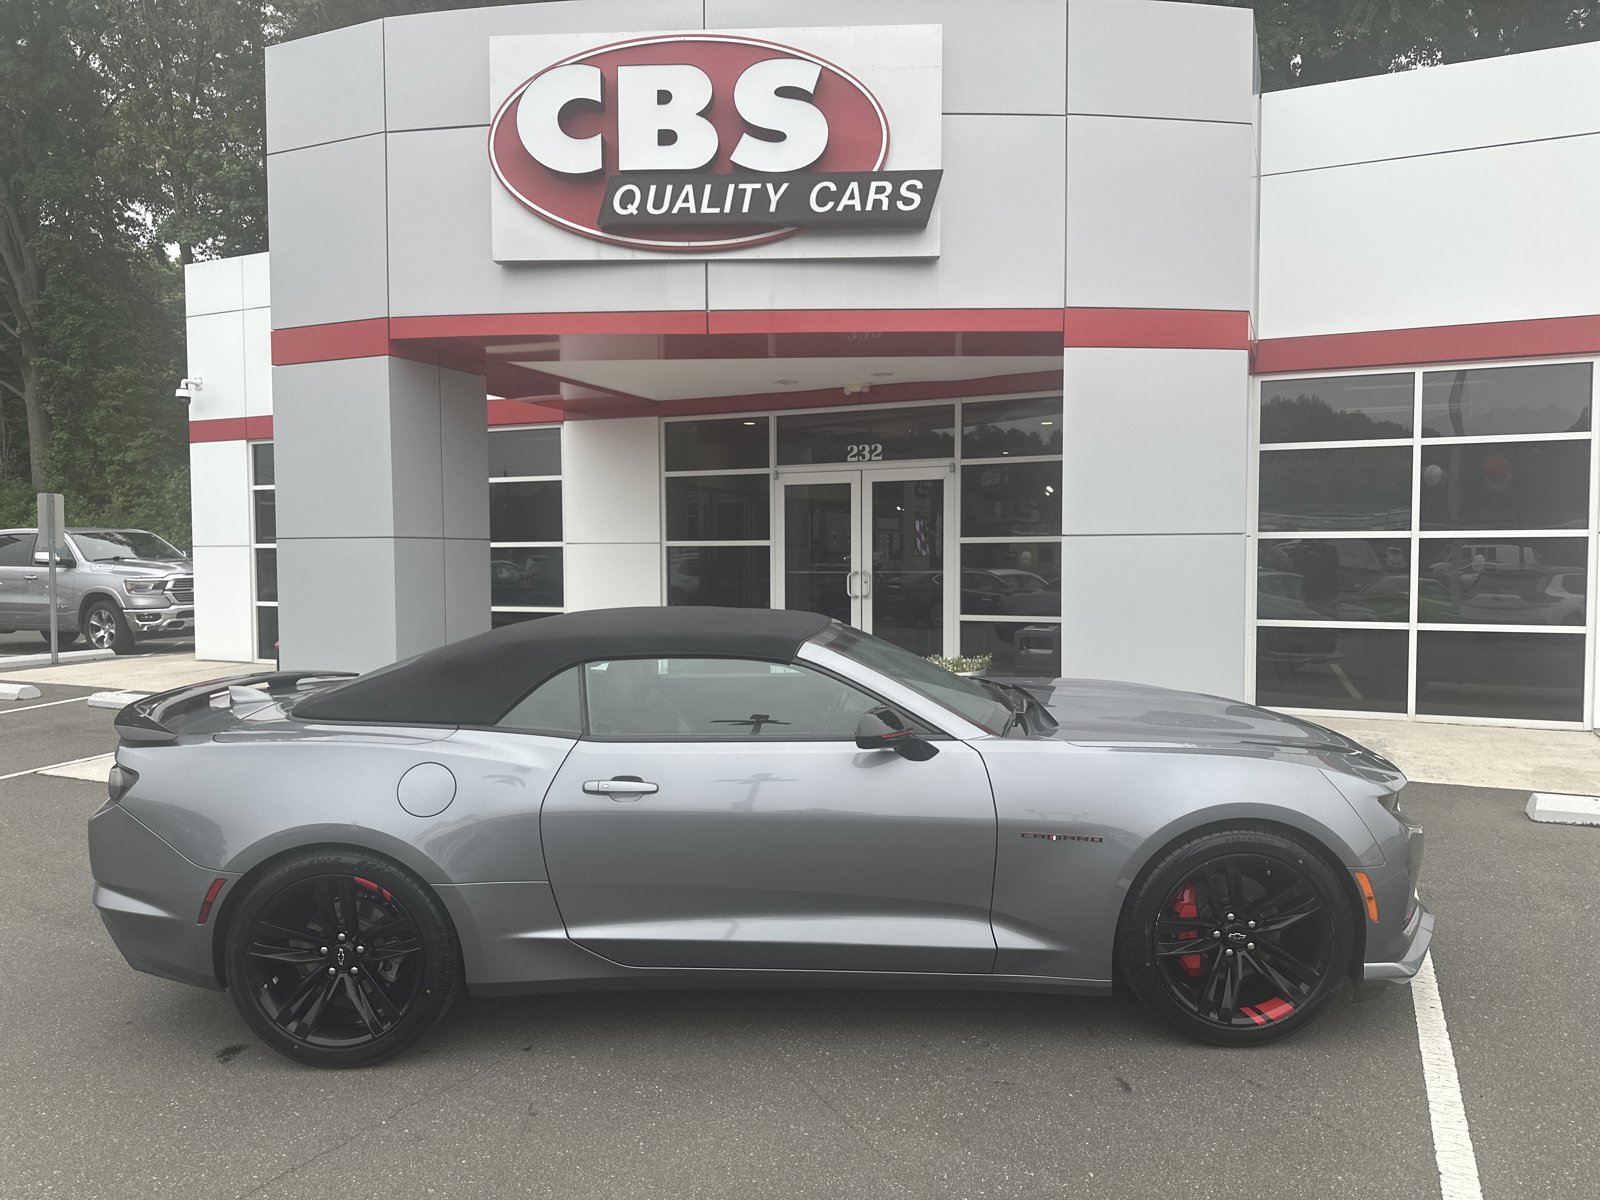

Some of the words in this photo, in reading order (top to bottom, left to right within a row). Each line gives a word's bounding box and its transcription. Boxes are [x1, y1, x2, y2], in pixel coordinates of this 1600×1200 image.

[515, 57, 830, 174] CBS
[612, 182, 789, 216] QUALITY
[808, 179, 924, 213] CARS
[846, 443, 883, 462] 232
